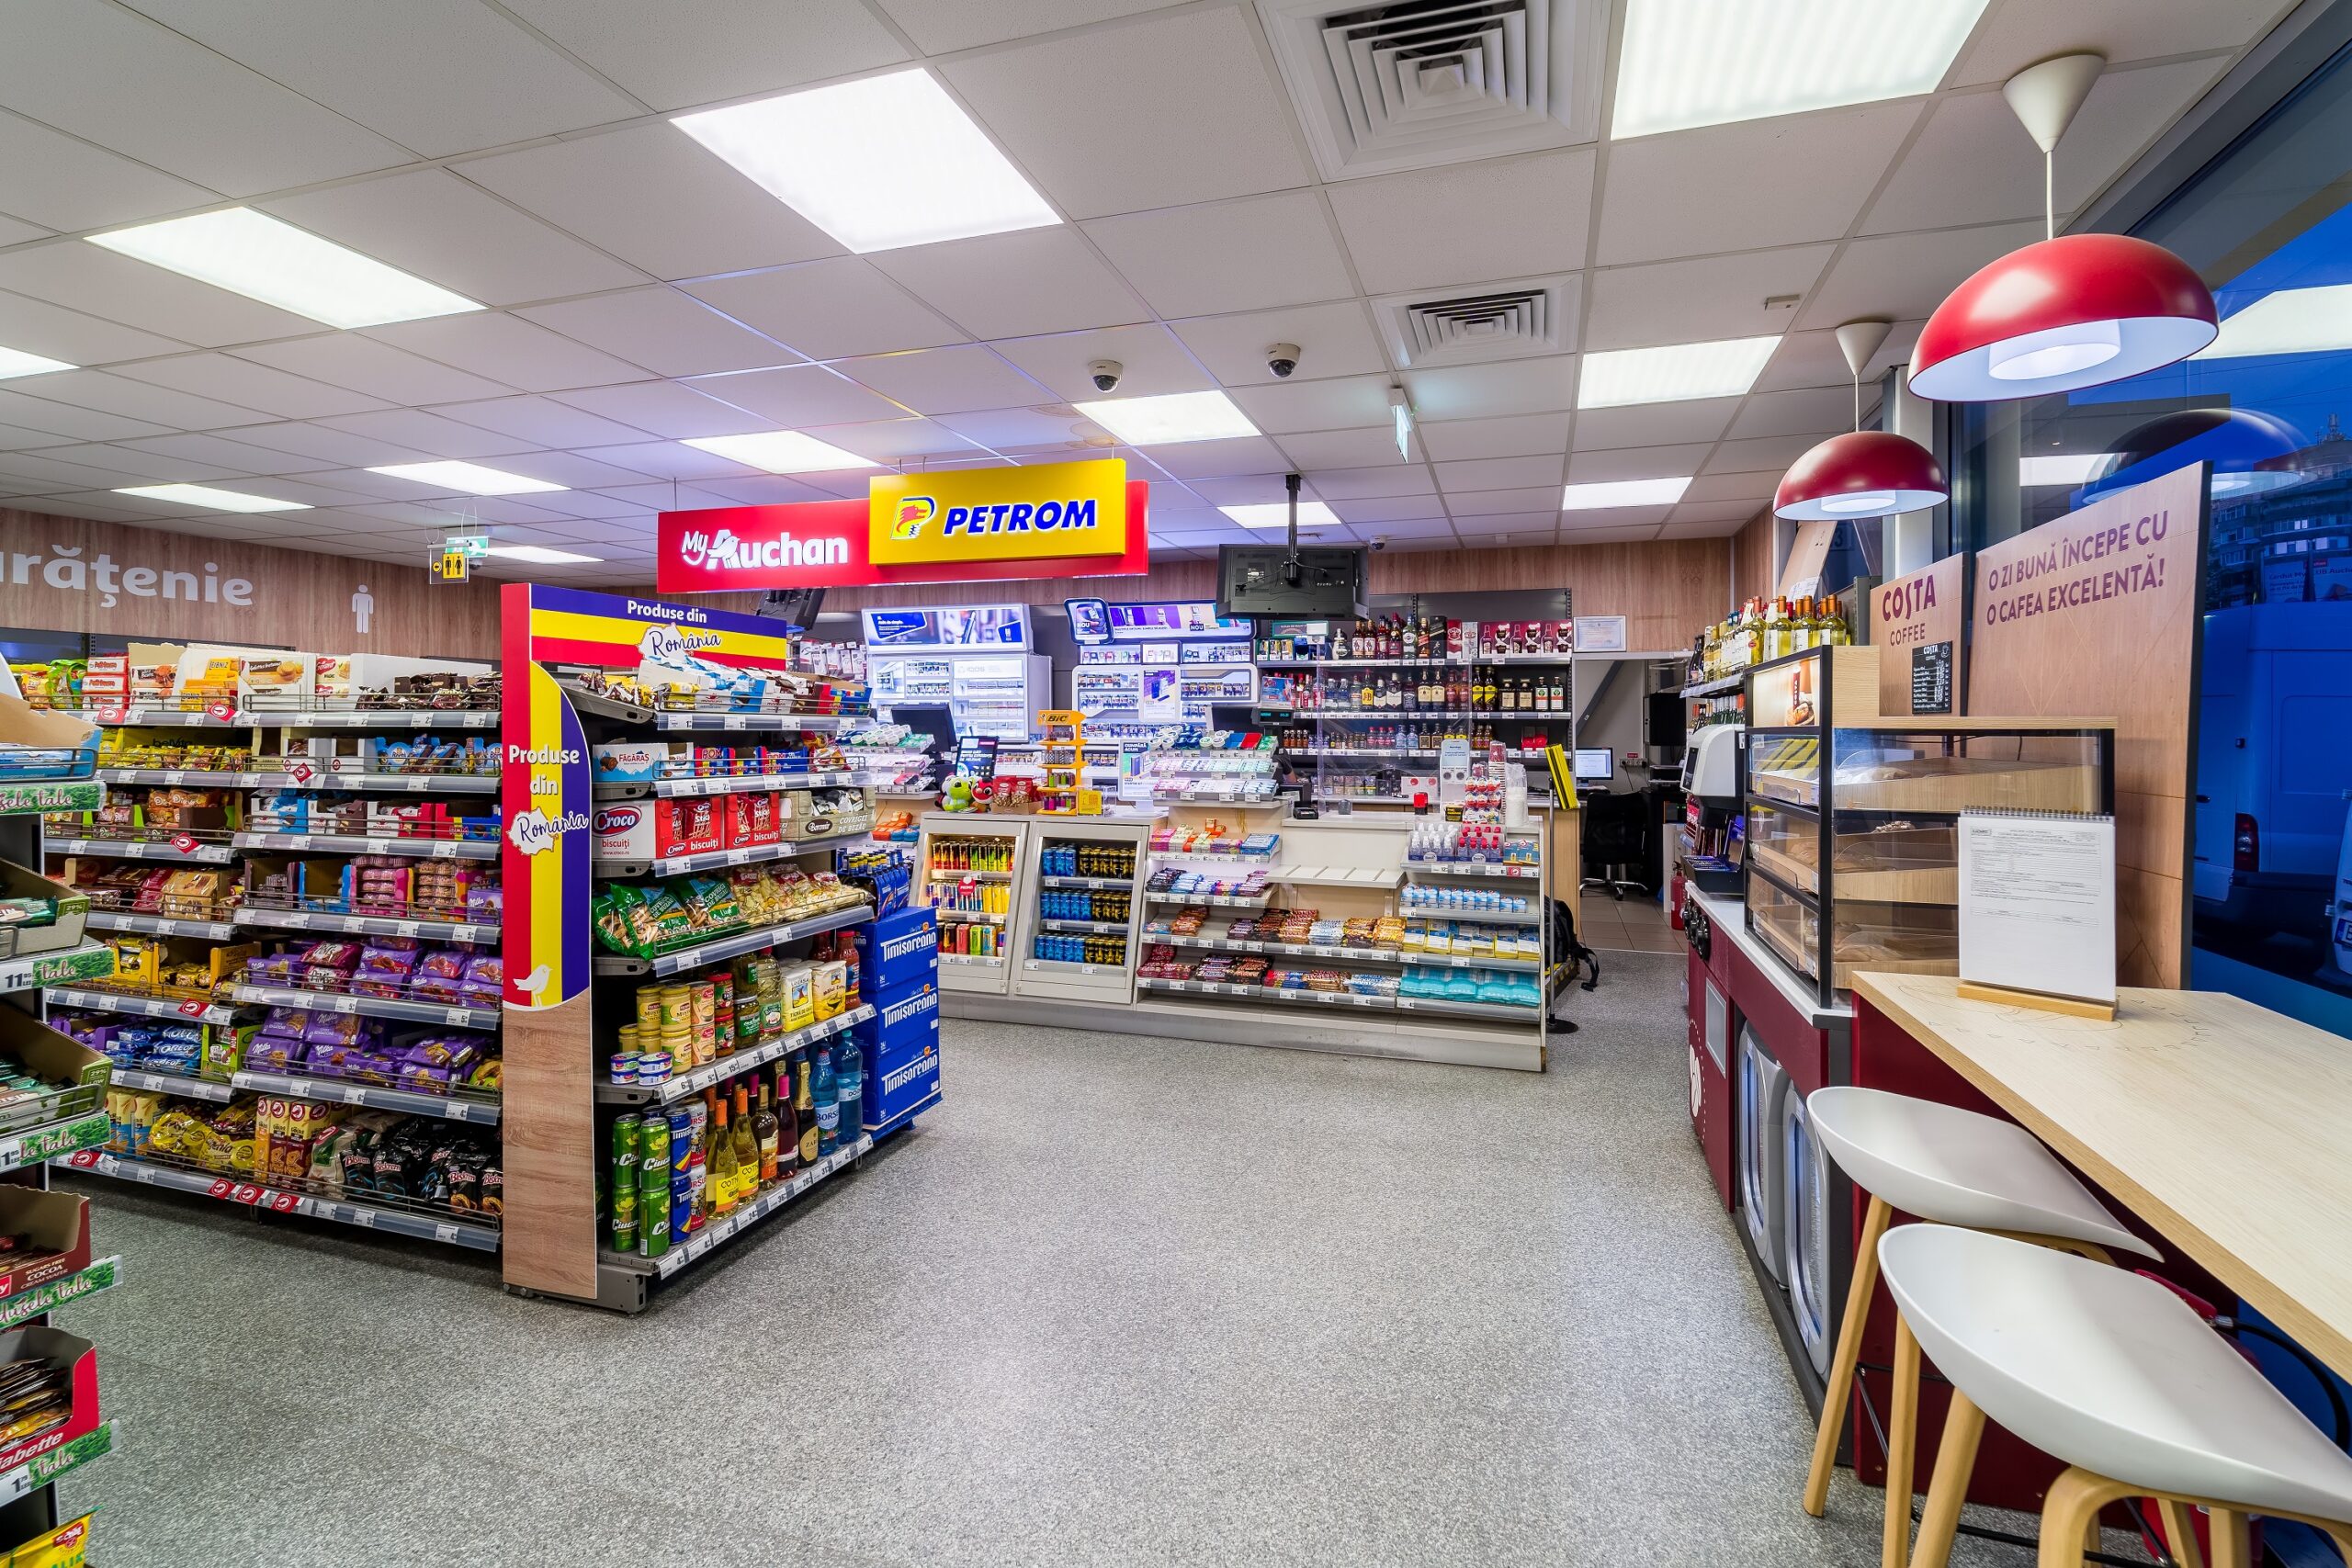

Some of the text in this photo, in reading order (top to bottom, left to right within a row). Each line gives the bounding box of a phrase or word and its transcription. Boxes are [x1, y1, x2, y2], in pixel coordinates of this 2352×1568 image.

[943, 498, 1097, 536] PETROM
[682, 529, 848, 570] My Auchan
[1989, 511, 2168, 591] O ZI BUNĂ ÎNCEPE CU
[0, 544, 254, 608] rățenie
[1883, 574, 1936, 622] COSTA
[1986, 553, 2165, 626] O CAFEA EXCELENTĂ!
[628, 600, 707, 624] Produse din
[649, 630, 721, 658] România
[1890, 622, 1926, 647] COFFEE
[1924, 645, 1939, 655] COSTA
[209, 661, 229, 670] LEIBNIZ
[509, 745, 580, 764] Produse
[702, 748, 723, 759] ROM
[530, 774, 559, 795] din
[35, 789, 73, 807] tale
[517, 812, 588, 843] România
[593, 811, 636, 831] Croco
[667, 844, 685, 853] Croco
[469, 897, 484, 907] Milka
[362, 948, 378, 959] Milka
[40, 960, 74, 980] tale
[412, 976, 427, 986] Milka
[462, 982, 480, 992] Milka
[252, 1042, 271, 1055] Milka
[315, 1043, 334, 1055] Milka
[41, 1131, 76, 1153] tale
[374, 1162, 401, 1173] Biskrem
[449, 1171, 476, 1183] Biskrem
[26, 1258, 65, 1275] SUGARS FREE
[27, 1264, 63, 1281] COCOA
[52, 1275, 91, 1298] tale
[37, 1450, 74, 1476] tale
